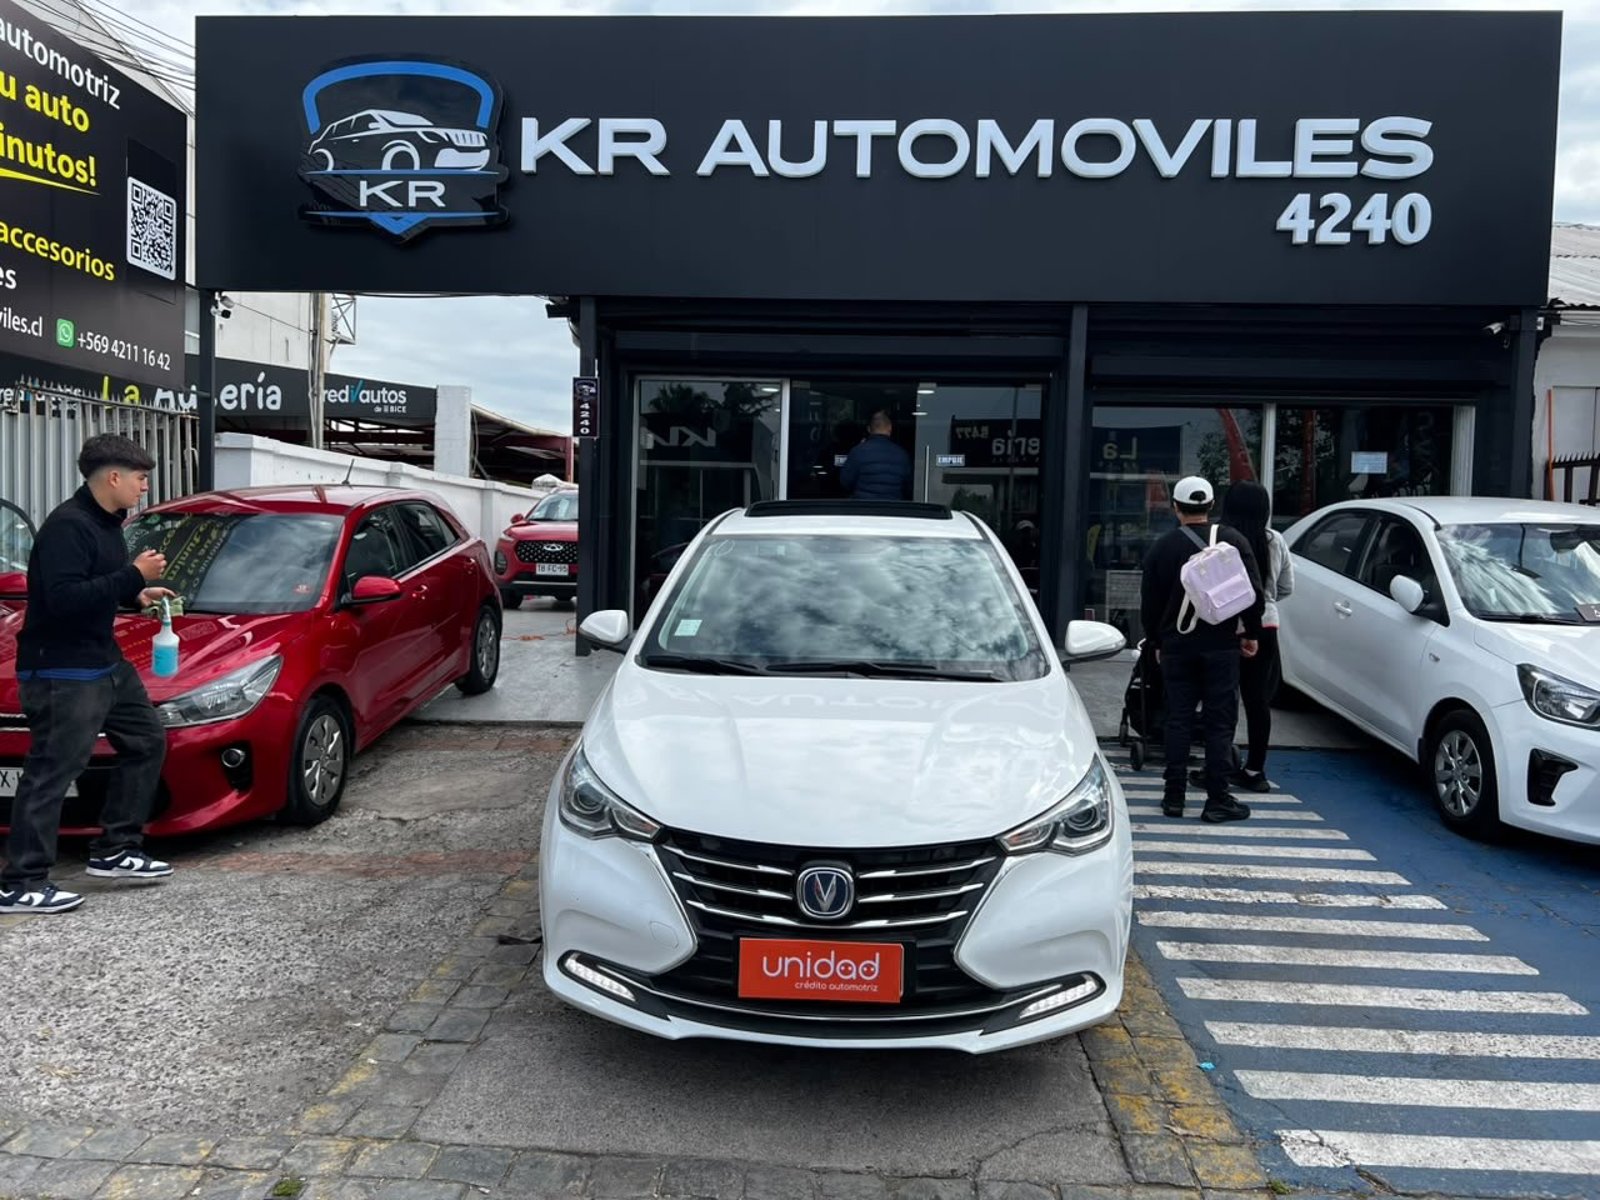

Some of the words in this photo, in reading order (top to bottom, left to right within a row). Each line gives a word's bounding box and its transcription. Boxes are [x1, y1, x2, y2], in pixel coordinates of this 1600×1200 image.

[25, 84, 90, 132] auto
[521, 117, 670, 175] KR
[696, 115, 1434, 180] AUTOMOVILES
[359, 180, 446, 207] KR
[1276, 192, 1432, 245] 4240
[77, 331, 109, 354] +569
[111, 339, 138, 362] 4211
[102, 375, 141, 410] La
[580, 402, 590, 435] 4240
[763, 950, 880, 981] unidad
[794, 980, 827, 990] crédito
[828, 983, 878, 992] automotriz
